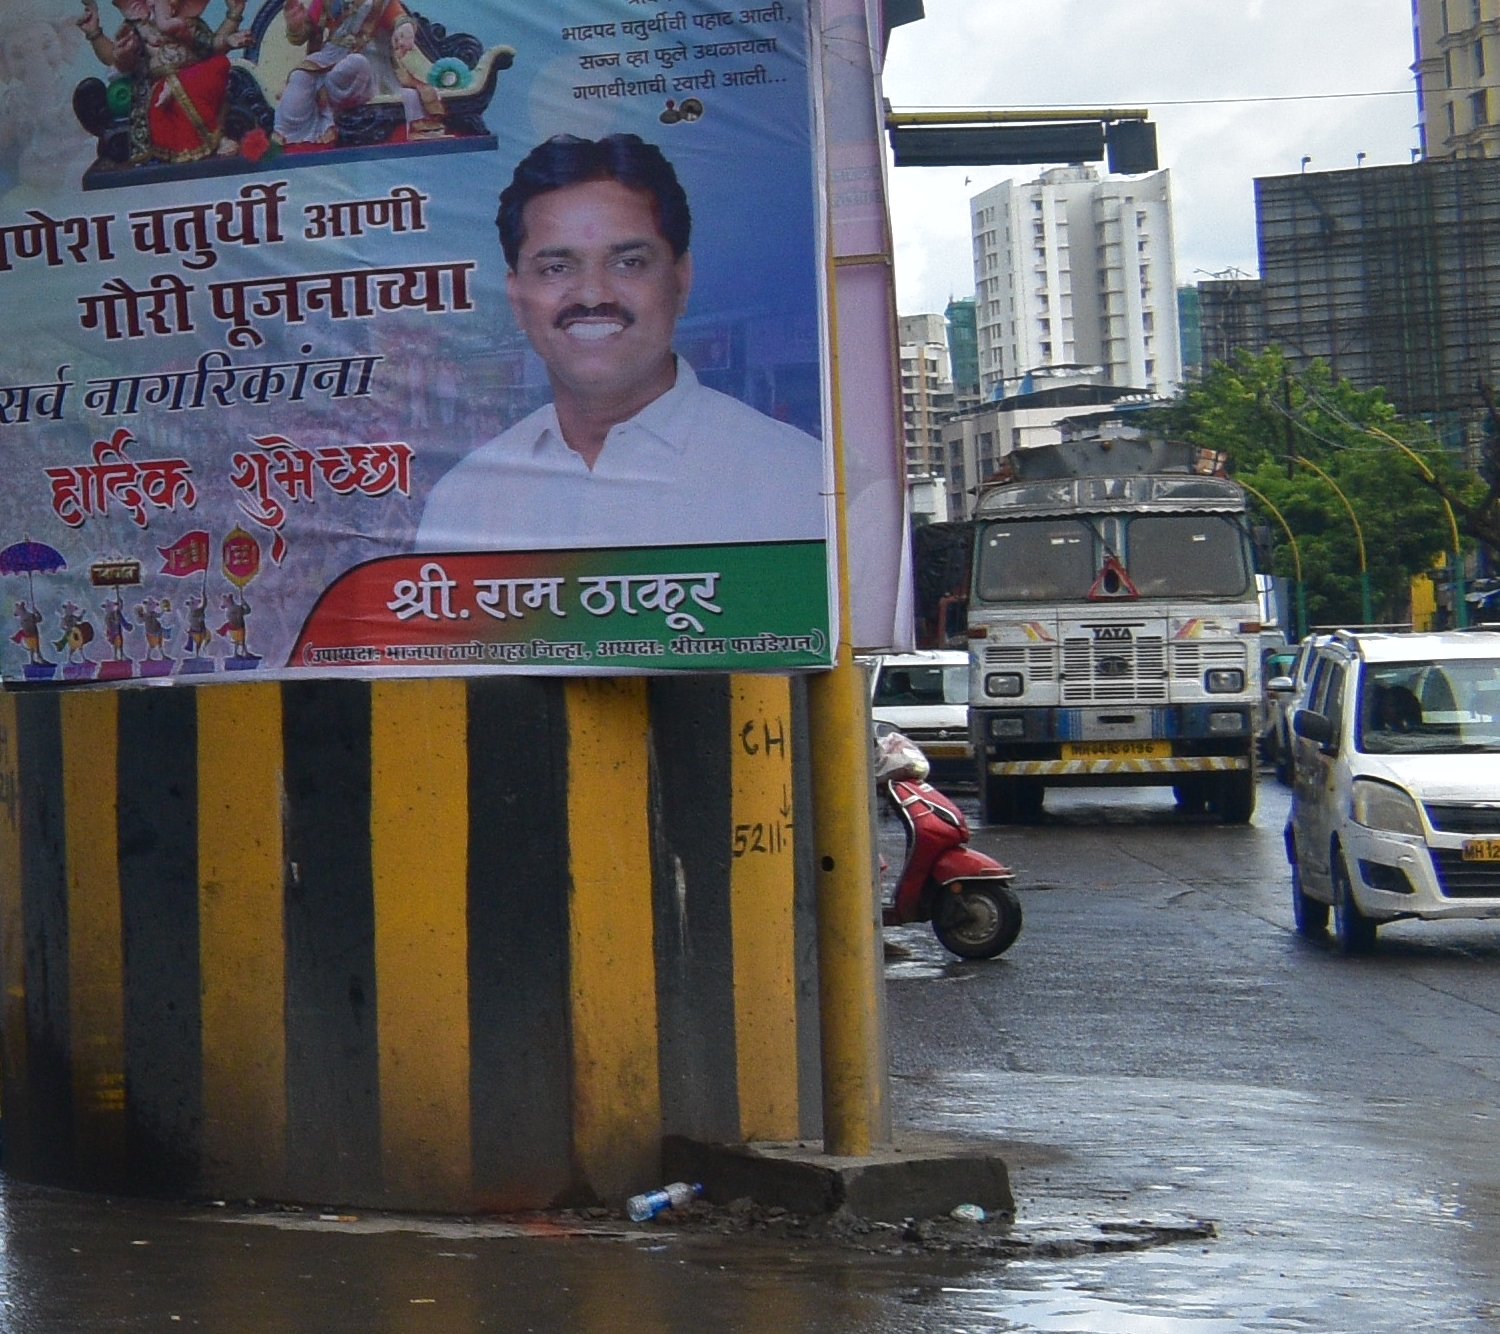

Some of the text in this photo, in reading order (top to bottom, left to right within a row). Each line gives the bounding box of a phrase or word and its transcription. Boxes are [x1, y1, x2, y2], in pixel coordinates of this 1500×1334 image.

[562, 23, 616, 42] भाद्रपद
[621, 11, 687, 41] चतुर्थीची
[691, 11, 734, 30] पहाट
[579, 37, 778, 70] सज्ज व्हा फुले उधळायला
[573, 74, 667, 100] गणाधीशाची
[672, 69, 716, 92] स्वारी
[128, 181, 288, 269] चतुर्थी
[303, 186, 428, 240] आणी
[78, 260, 477, 348] गौरी पूजनाच्या
[84, 343, 385, 417] नागरिकांना
[44, 427, 415, 547] हार्दिक शुभेच्छा
[579, 572, 722, 633] ठाकूर
[384, 641, 445, 662] भाजपा
[449, 638, 484, 661] ठाणे
[489, 639, 528, 663] शहर
[671, 633, 726, 656] श्रीराम
[1092, 627, 1133, 639] TATA
